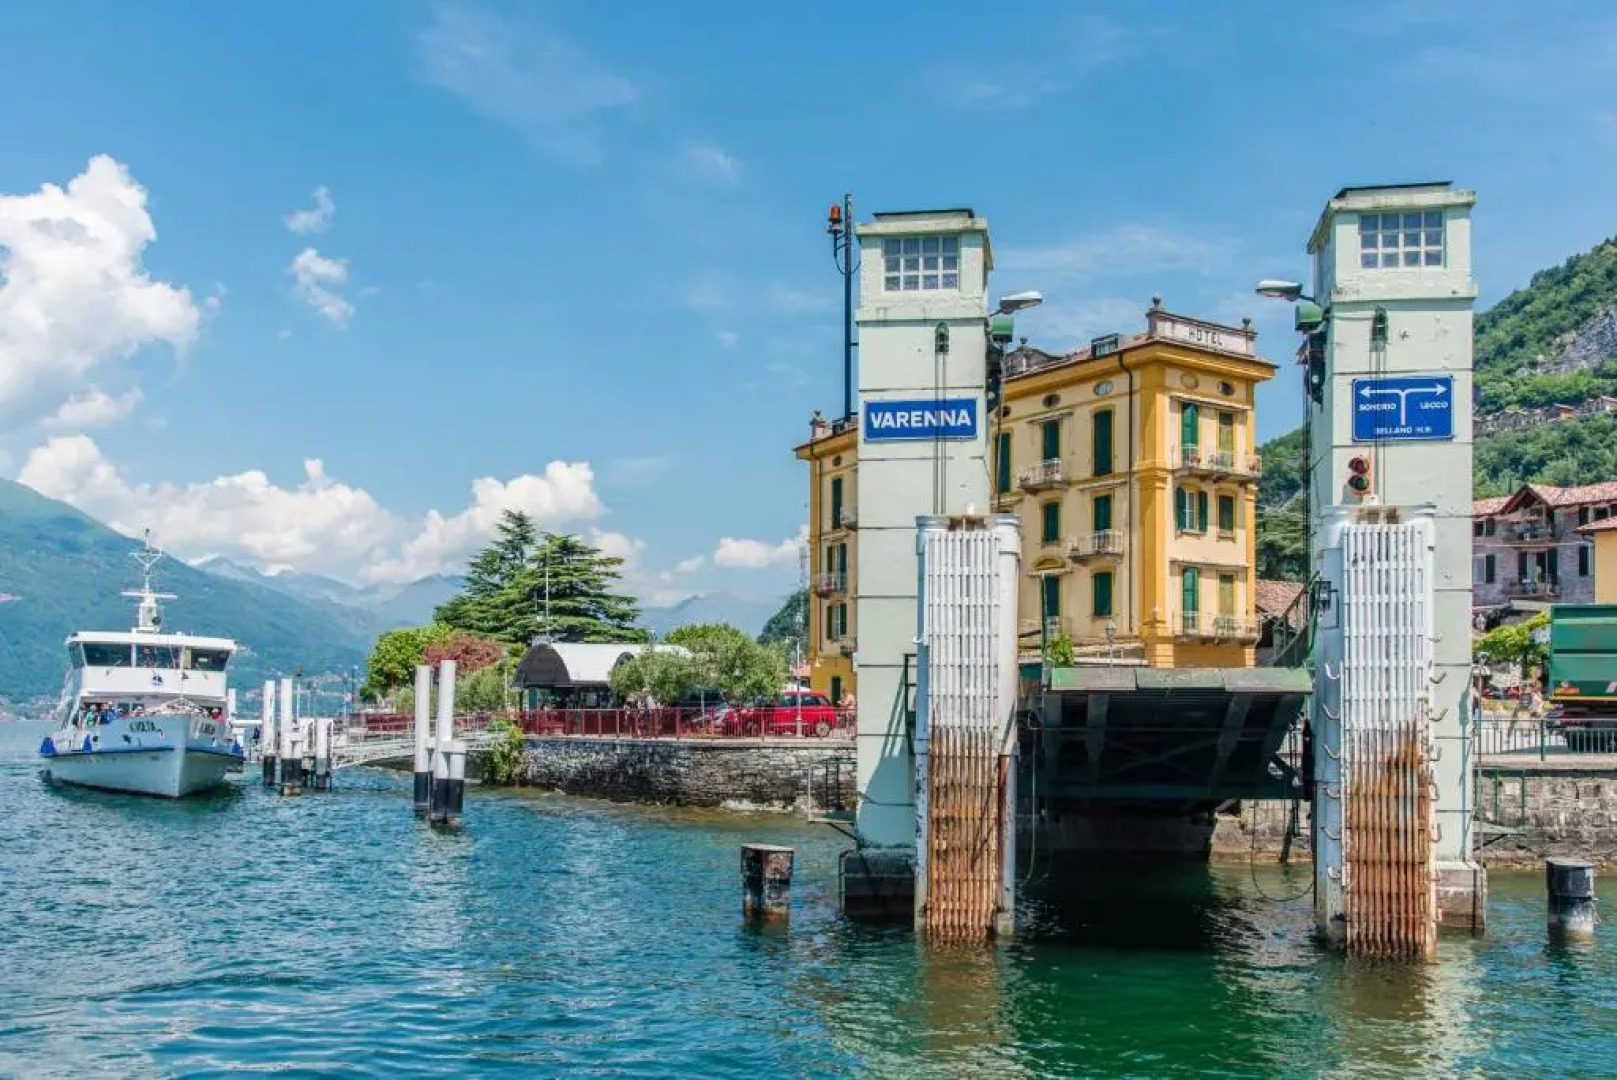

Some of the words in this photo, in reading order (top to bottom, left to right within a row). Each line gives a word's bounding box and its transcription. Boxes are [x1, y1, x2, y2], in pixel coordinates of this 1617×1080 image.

[1189, 327, 1222, 347] HOTEL
[1420, 401, 1448, 410] LECCO
[870, 409, 972, 428] VARENNA
